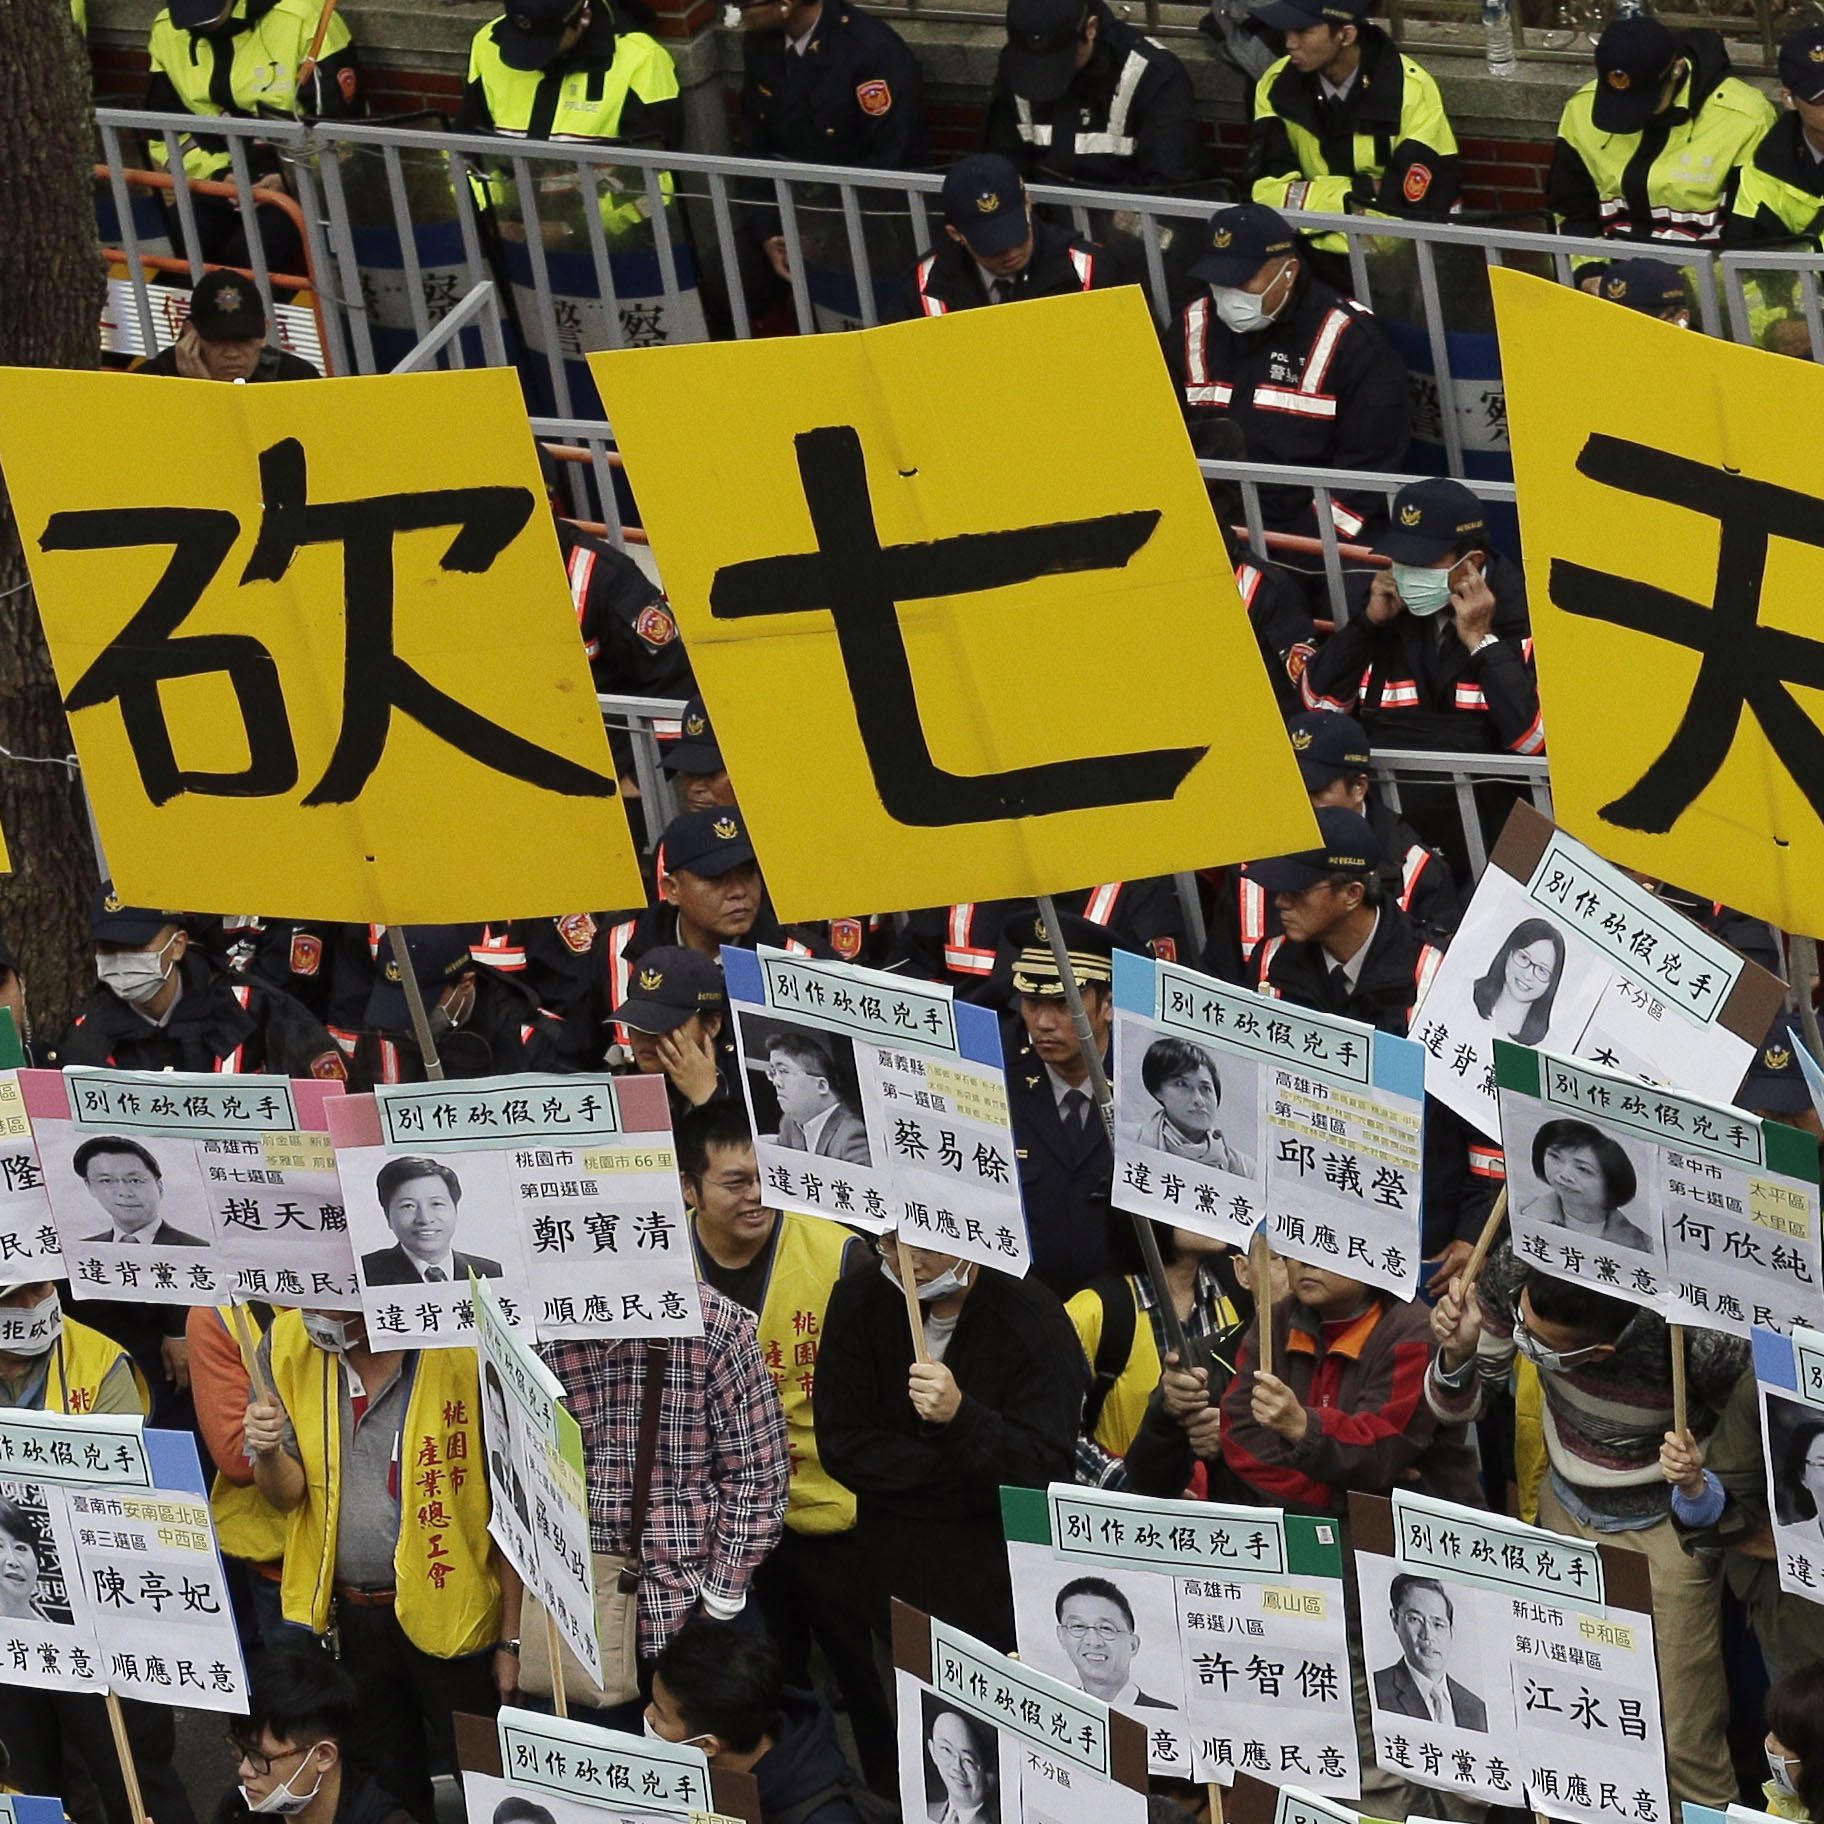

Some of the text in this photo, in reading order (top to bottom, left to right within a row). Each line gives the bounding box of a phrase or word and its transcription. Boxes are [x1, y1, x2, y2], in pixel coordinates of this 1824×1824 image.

[38, 436, 615, 805] 砍
[711, 426, 1208, 830] 七
[1542, 868, 1713, 1002] 別作砍假兇手
[1615, 977, 1665, 1022] 不分區
[83, 1089, 281, 1121] 別作砍假兇手
[882, 1082, 947, 1111] 第一選區
[1275, 1072, 1329, 1099] 高雄市
[208, 1165, 284, 1185] 第七選區
[515, 1150, 574, 1169] 桃園市
[893, 1119, 1010, 1184] 蔡易餘
[1275, 1135, 1409, 1209] 邱議瑩
[1667, 1153, 1723, 1179] 臺中市
[533, 1212, 676, 1254] 鄭寶清
[903, 1200, 1020, 1257] 順應民意
[1275, 1213, 1409, 1277] 順應民意
[1672, 1213, 1811, 1285] 何欣純
[1524, 1234, 1660, 1297] 違背黨意
[442, 1400, 467, 1496] 桃園市
[80, 1527, 148, 1551] 第三選區
[417, 1436, 454, 1590] 產業總工會
[533, 1500, 589, 1594] 羅致政
[1410, 1522, 1590, 1587] 別作砍假兇手
[91, 1565, 222, 1615] 陳亭妃
[1183, 1580, 1242, 1600] 高雄市
[1192, 1651, 1338, 1701] 許智傑
[1515, 1634, 1602, 1670] 第八選舉區
[1523, 1678, 1648, 1741] 江永昌
[1027, 1751, 1071, 1786] 不分區
